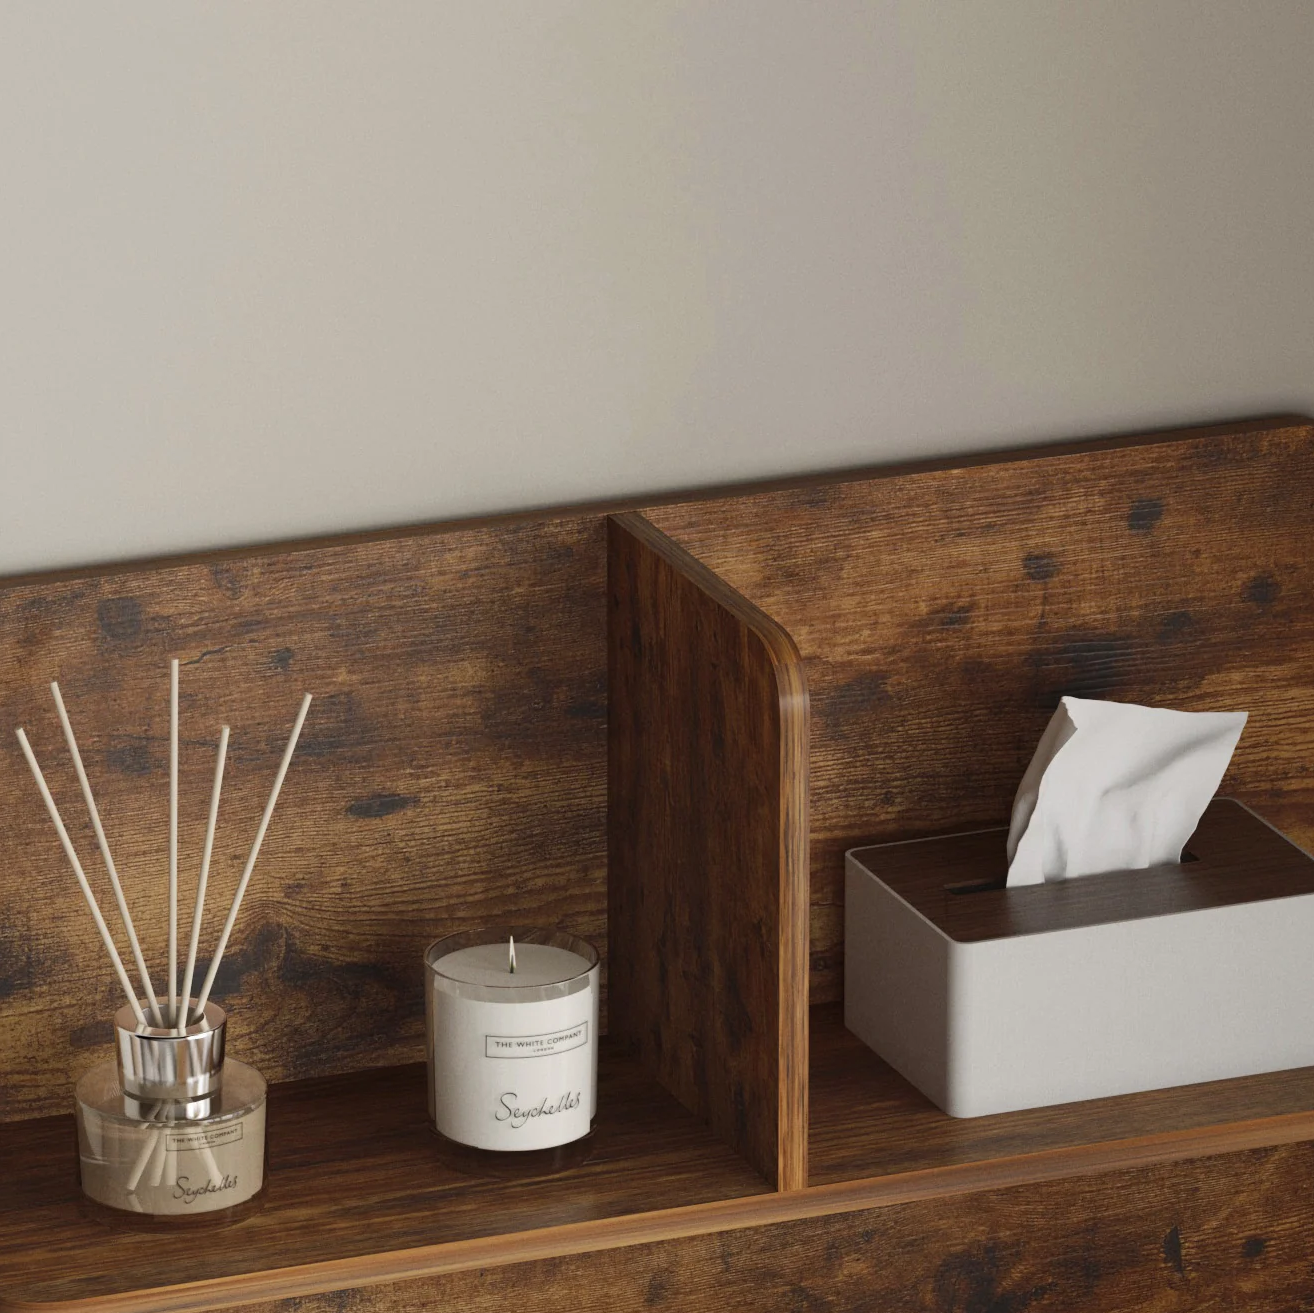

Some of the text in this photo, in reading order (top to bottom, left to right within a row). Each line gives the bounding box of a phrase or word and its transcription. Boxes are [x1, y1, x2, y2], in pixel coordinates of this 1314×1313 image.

[516, 1039, 544, 1048] WHITE
[547, 1030, 582, 1045] COMPANY
[494, 1091, 581, 1129] Seychelles
[173, 1174, 238, 1205] Seychelles
